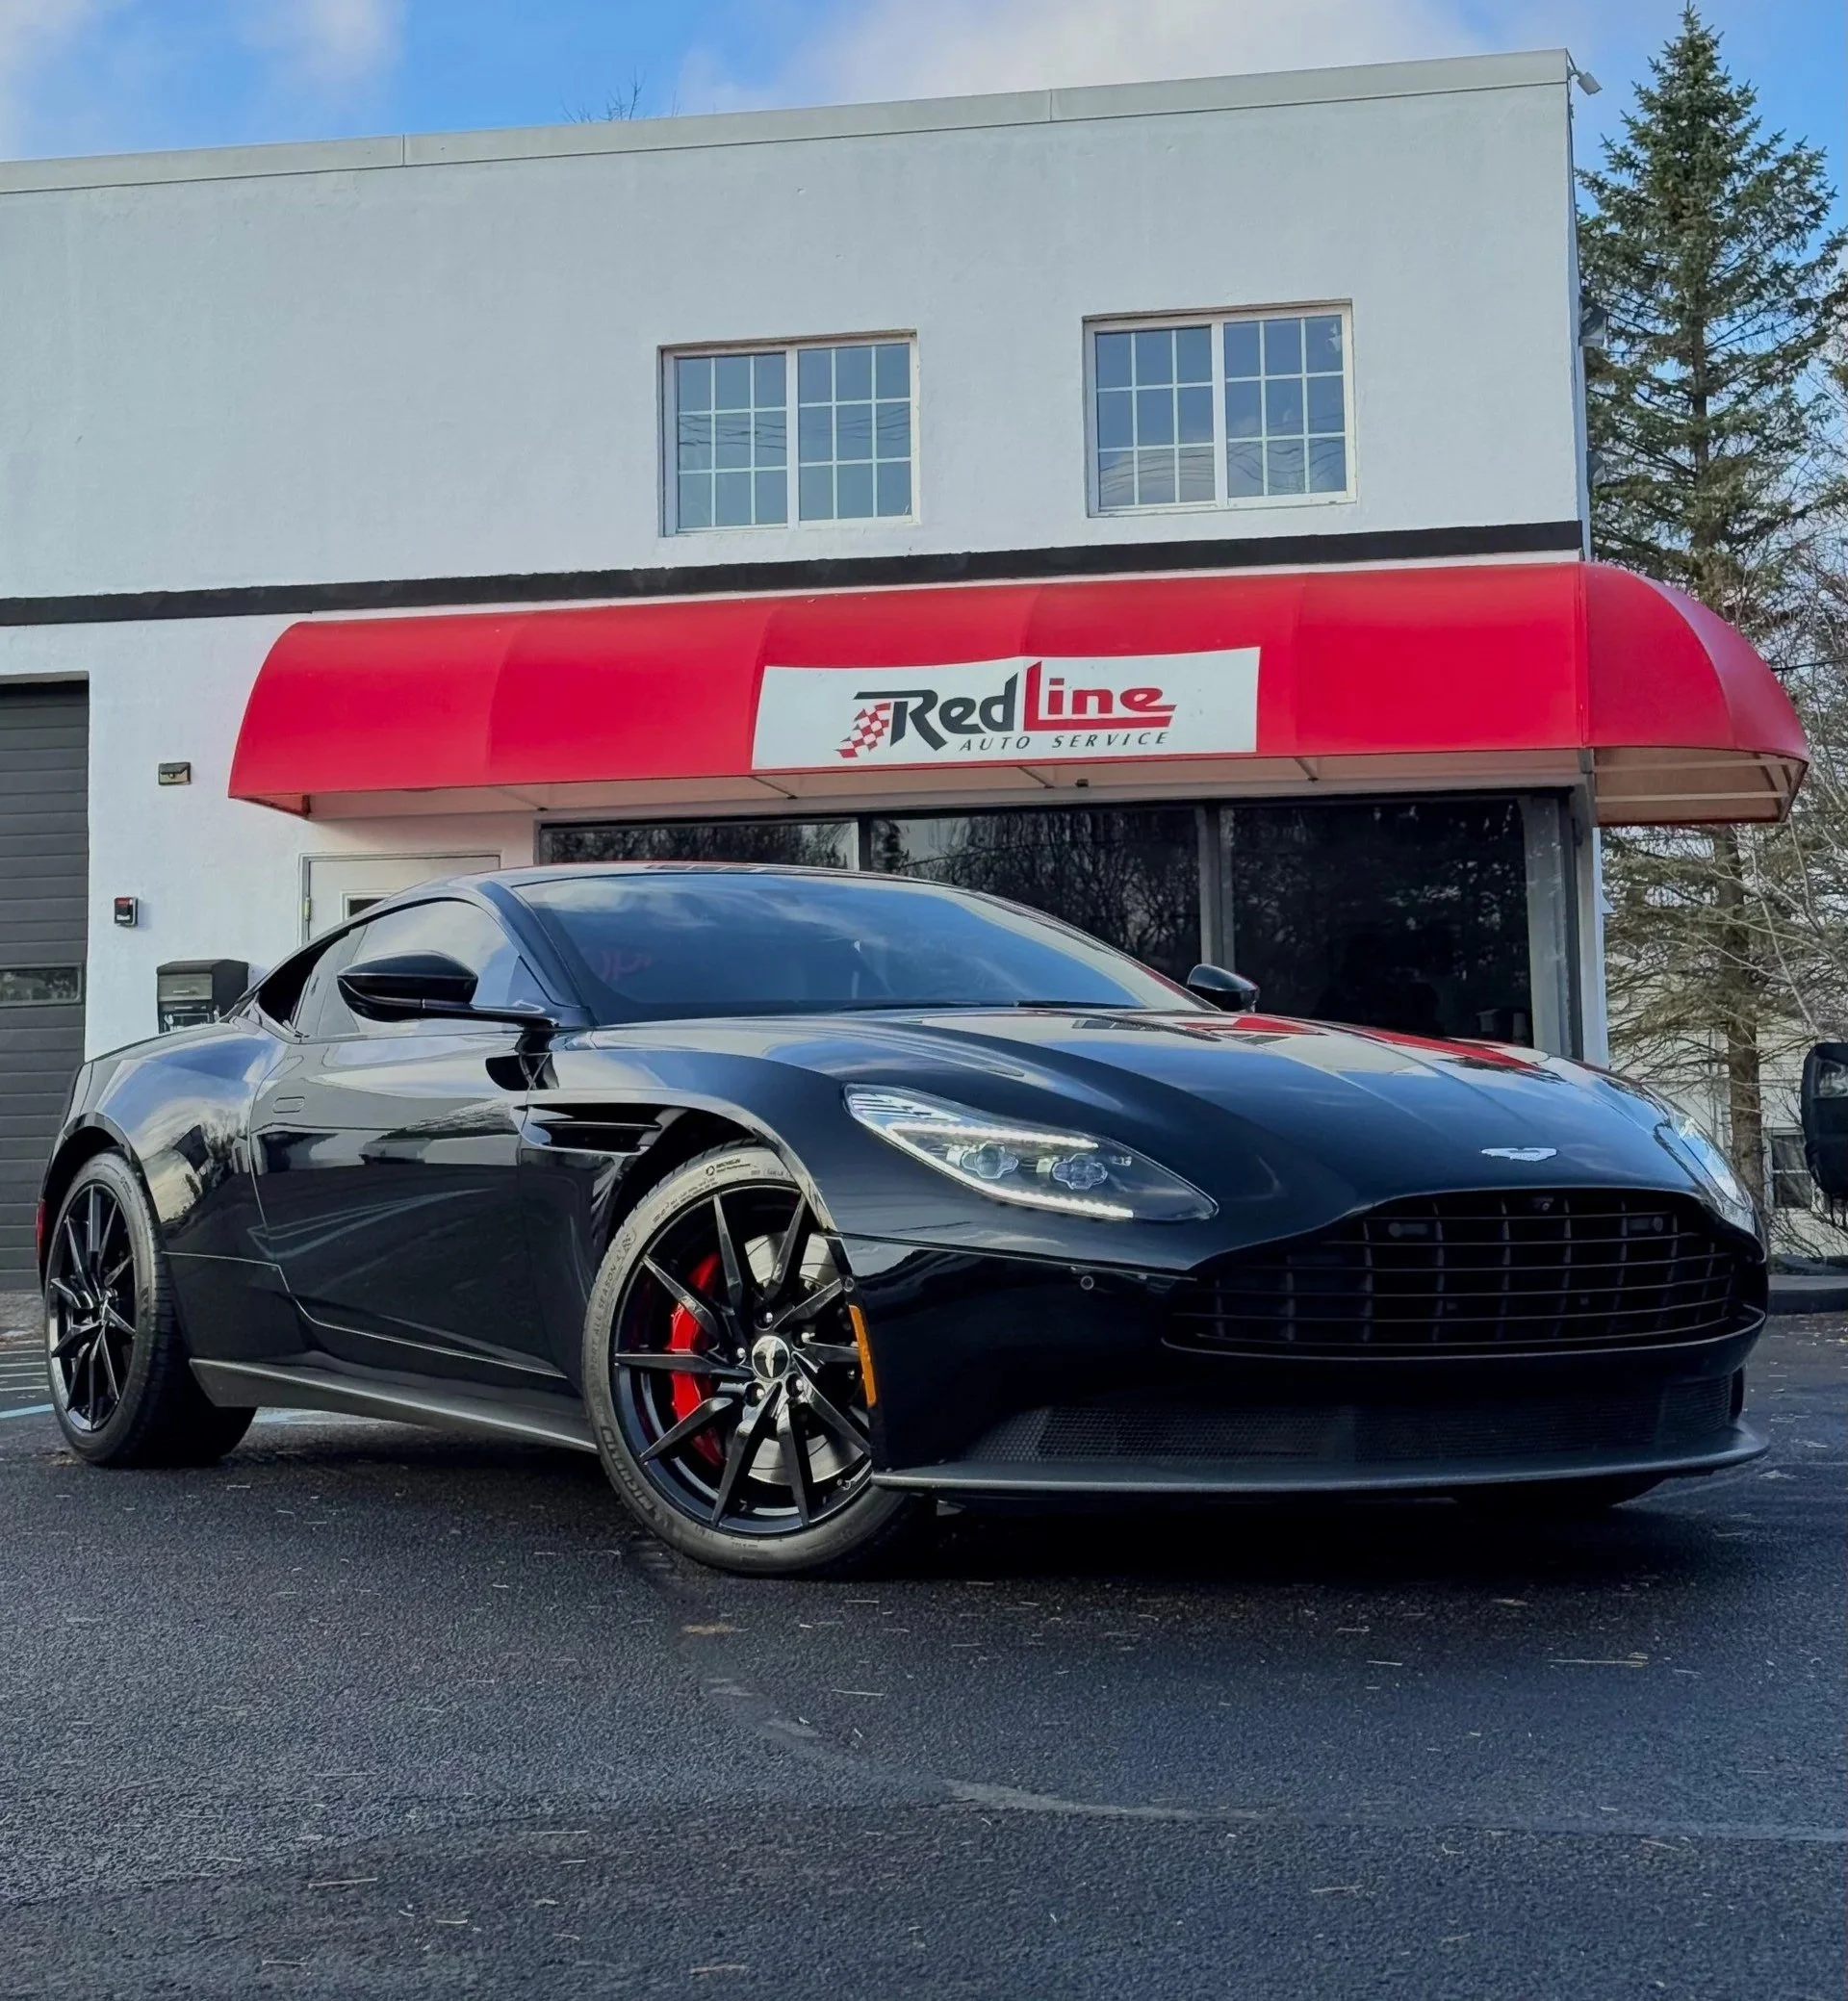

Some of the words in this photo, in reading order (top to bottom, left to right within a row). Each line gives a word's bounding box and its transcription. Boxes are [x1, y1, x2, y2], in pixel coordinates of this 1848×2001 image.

[959, 734, 1031, 752] AUTO
[1052, 731, 1170, 749] SERVICE
[598, 1265, 616, 1310] SEASON
[601, 1426, 654, 1511] MICHELIN
